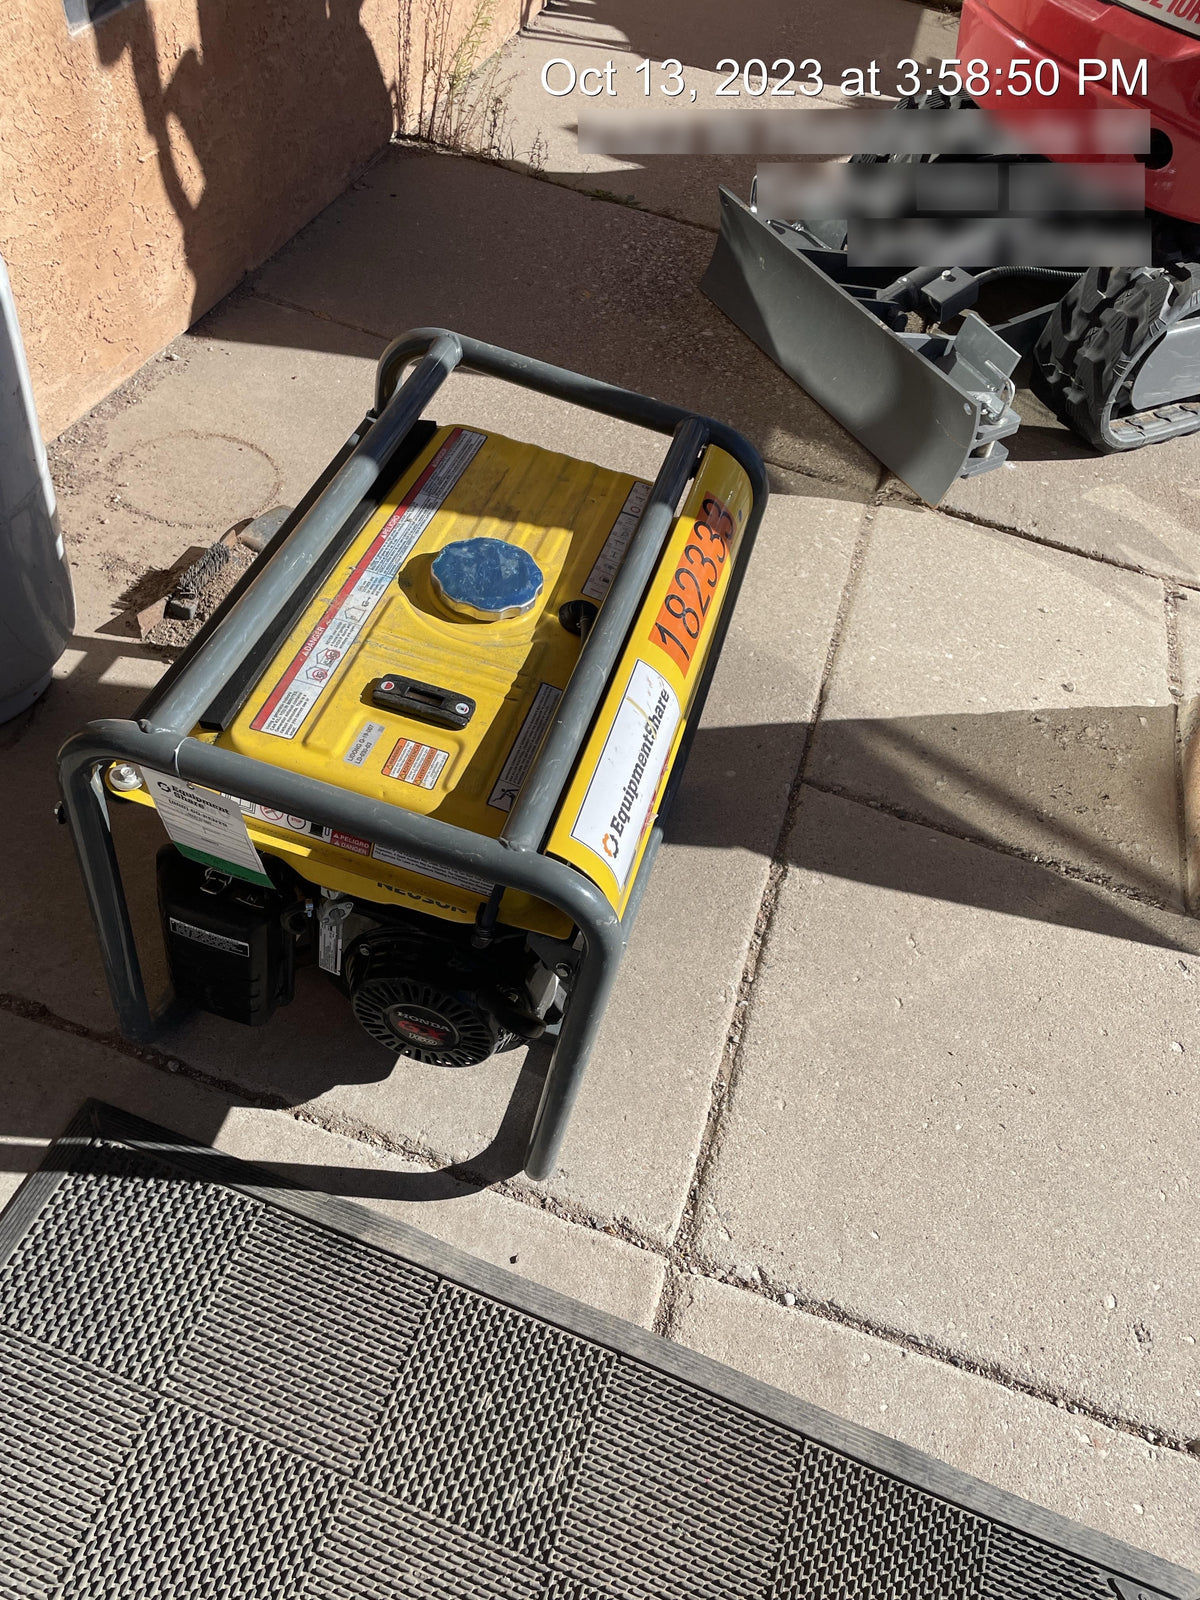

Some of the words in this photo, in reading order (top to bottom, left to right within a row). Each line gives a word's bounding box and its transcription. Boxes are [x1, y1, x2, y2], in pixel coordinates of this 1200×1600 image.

[383, 515, 400, 536] PELIGRO
[655, 498, 734, 661] 182333
[305, 626, 325, 652] DANGER
[610, 688, 670, 837] EquipmentShare
[171, 785, 231, 815] Equipment
[174, 791, 205, 810] Share
[339, 834, 370, 849] PELIGRO
[340, 842, 367, 856] DANGER
[397, 1011, 451, 1033] HONDA
